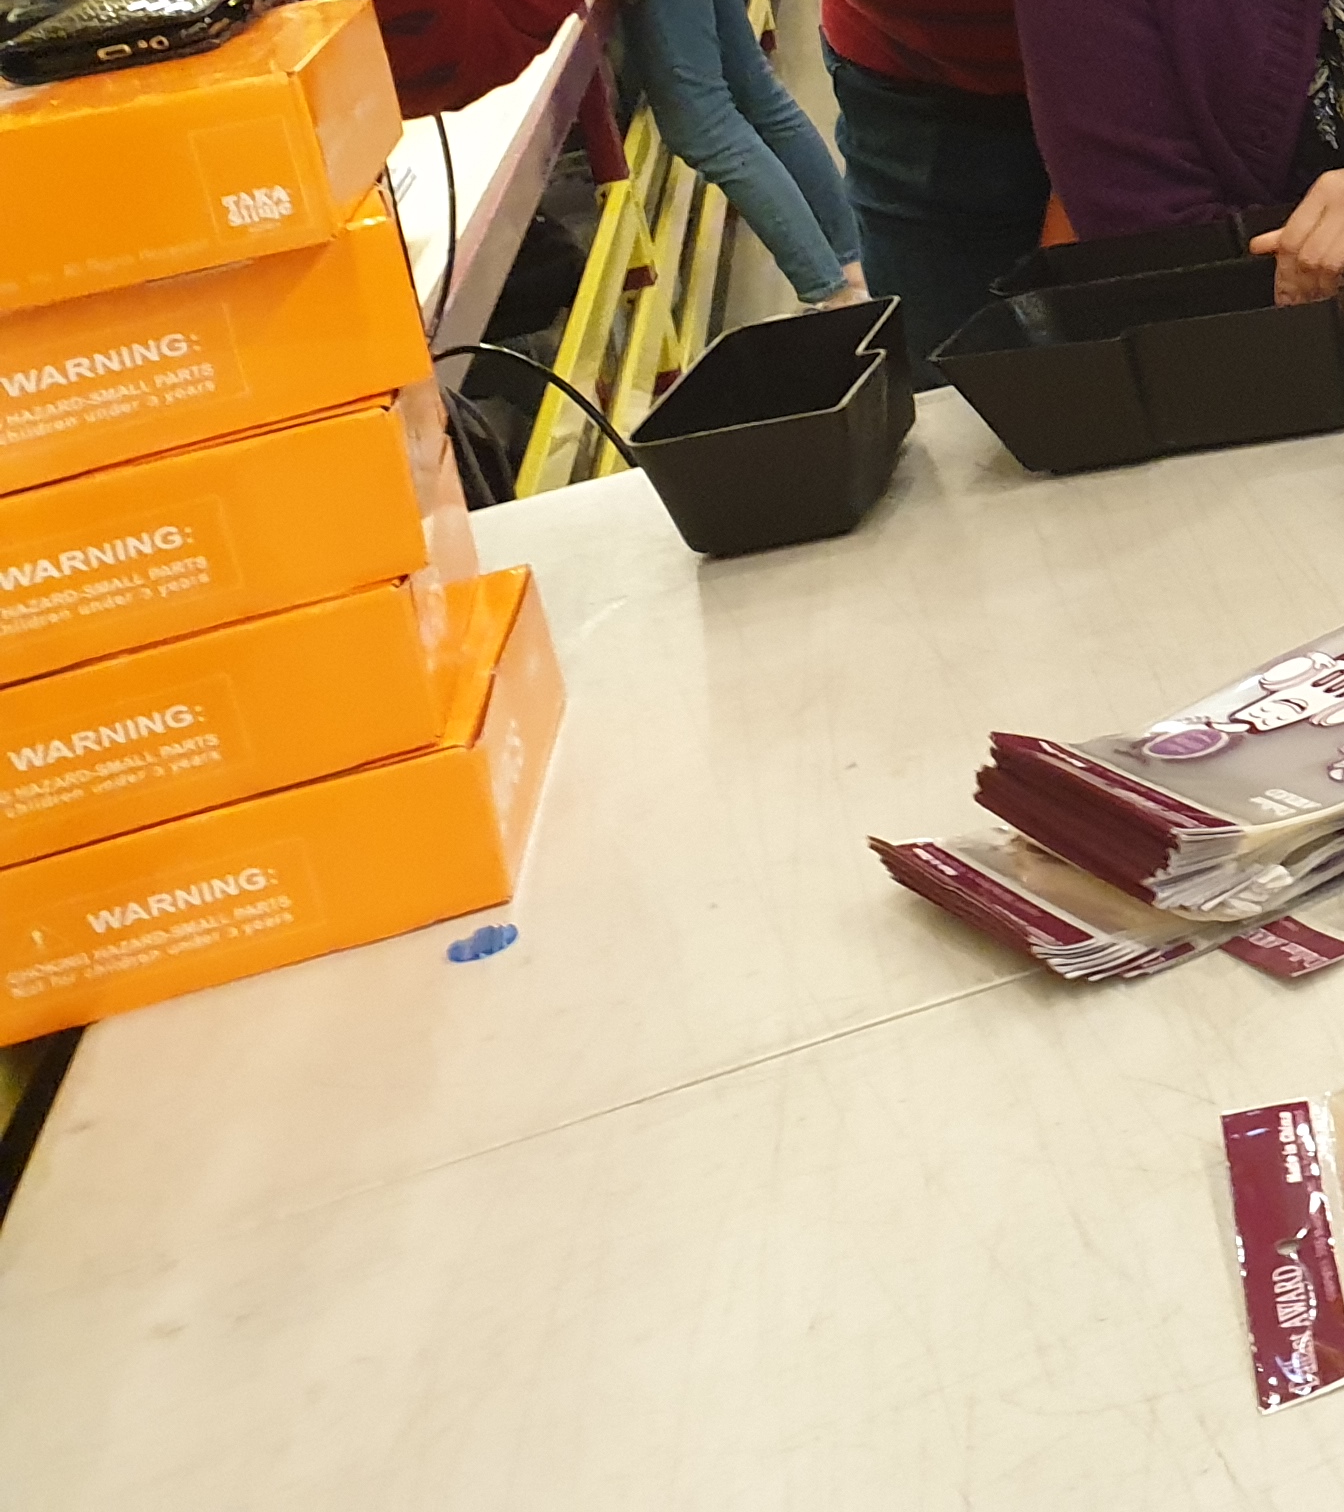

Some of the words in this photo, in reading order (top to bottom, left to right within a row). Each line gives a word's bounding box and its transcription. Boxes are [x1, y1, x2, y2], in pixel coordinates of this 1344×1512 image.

[0, 333, 201, 397] WARNING:
[154, 363, 215, 388] PARTS
[0, 526, 194, 591] WARNING:
[7, 704, 205, 771] WARNING:
[87, 868, 279, 934] WARNING:
[1272, 1265, 1312, 1328] AWARD
